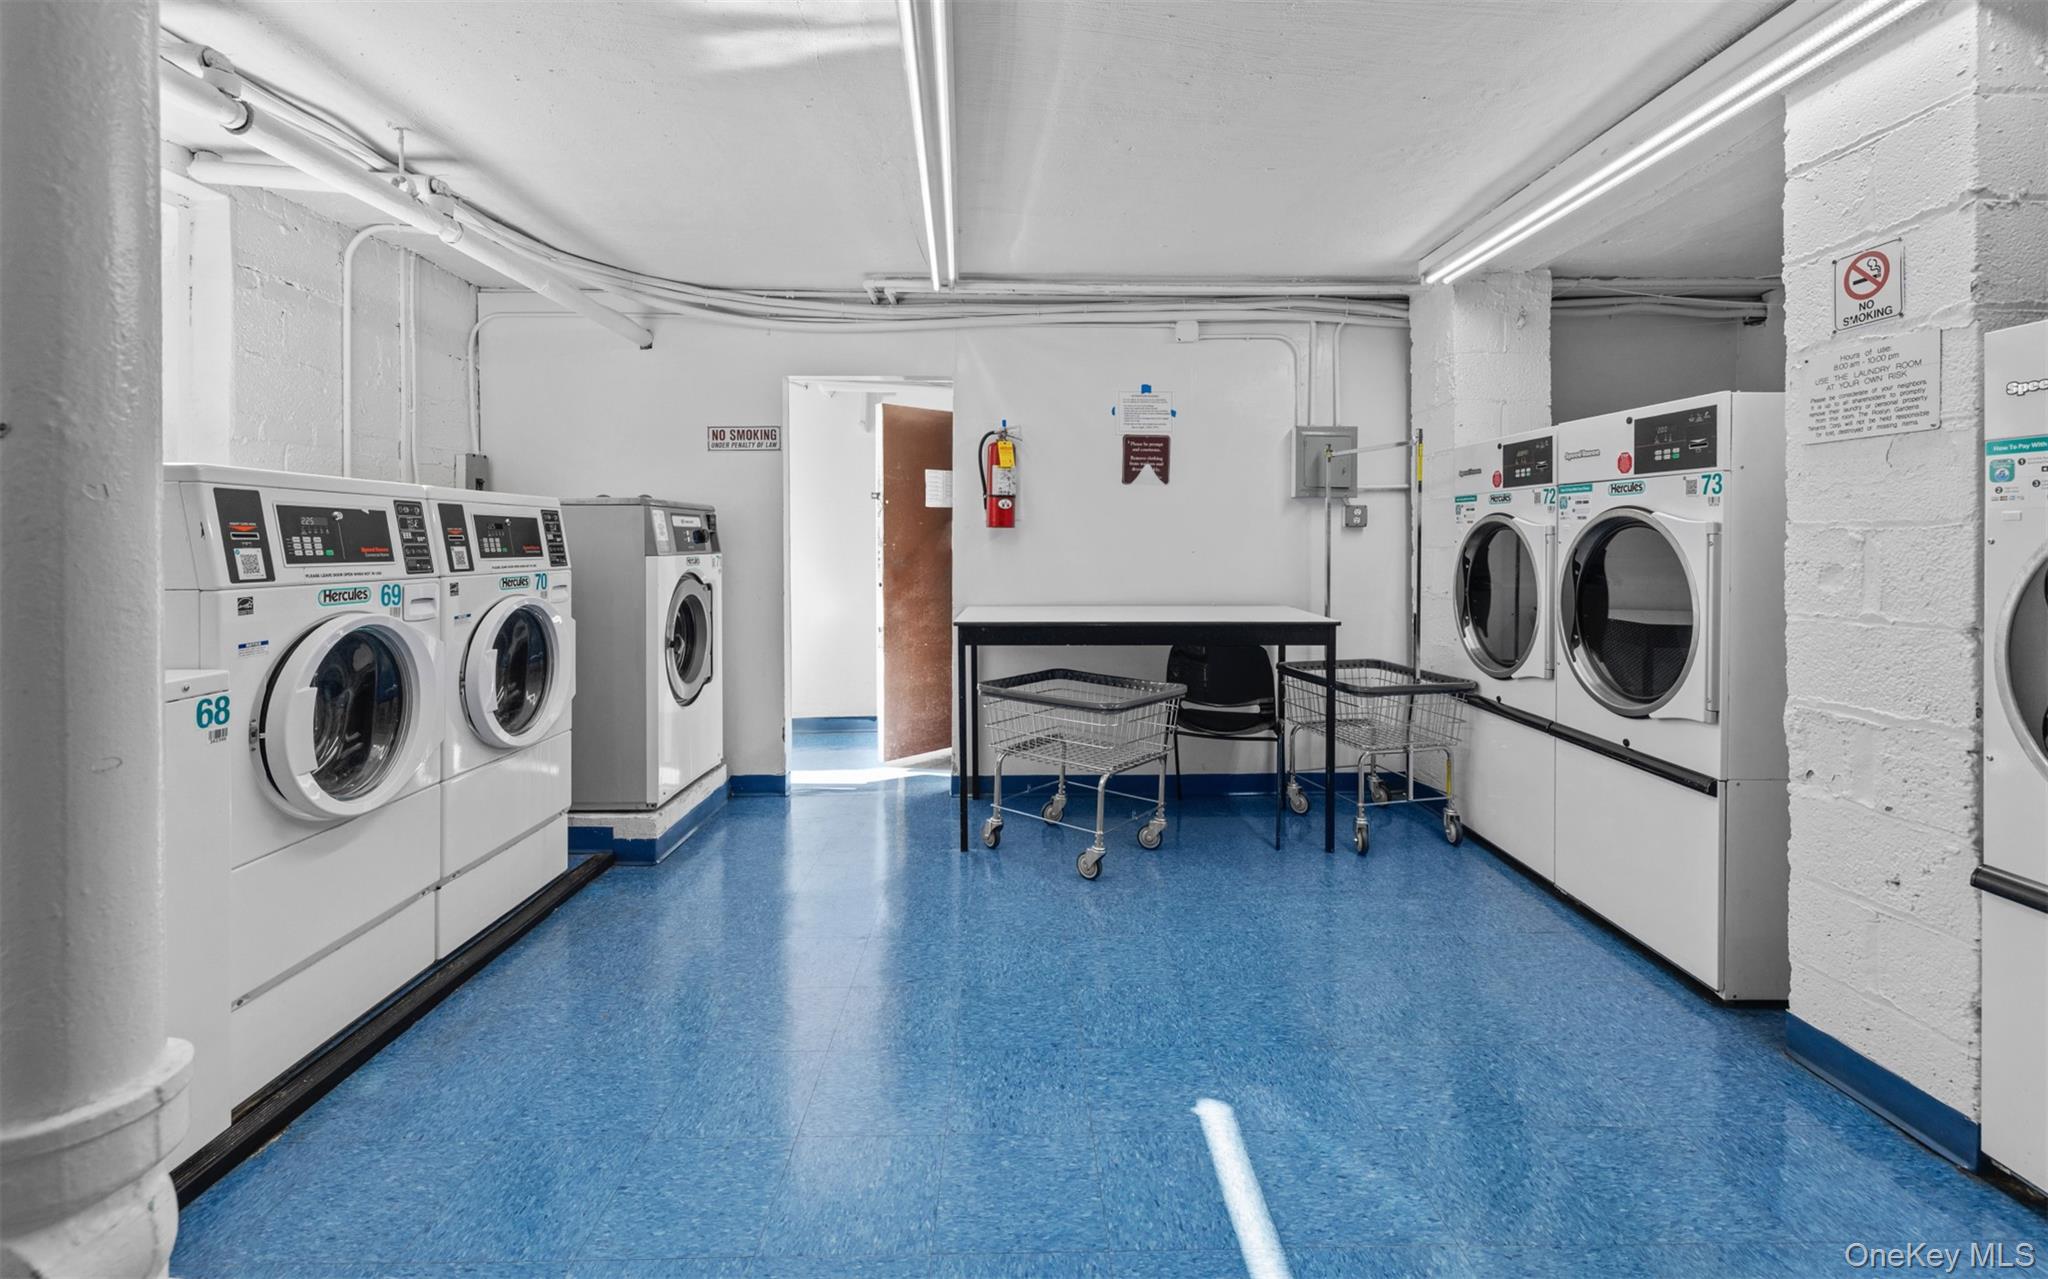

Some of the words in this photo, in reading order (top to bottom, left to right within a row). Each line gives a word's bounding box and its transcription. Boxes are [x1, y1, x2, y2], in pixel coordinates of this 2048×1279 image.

[1859, 300, 1875, 311] NO
[1843, 306, 1893, 327] SMOKING
[1840, 353, 1860, 363] Hours
[1864, 348, 1872, 357] of
[1815, 376, 1829, 386] USE
[1834, 372, 1848, 382] THE
[1853, 365, 1891, 379] LAUNDRY
[1896, 358, 1922, 370] ROOM
[1826, 383, 1835, 391] AT
[1839, 379, 1859, 390] YOUR
[1864, 375, 1882, 385] OWN
[1888, 370, 1907, 380] RISK
[1900, 387, 1926, 397] promptly
[1874, 399, 1898, 409] personal
[1902, 394, 1928, 405] property
[1894, 404, 1920, 413] Gardens
[1896, 410, 1930, 420] responsible
[711, 429, 726, 441] NO
[729, 429, 777, 441] SMOKING
[711, 441, 730, 449] UNDER
[731, 441, 756, 449] PENALTY
[756, 441, 764, 449] OF
[765, 441, 778, 449] LAW
[2018, 443, 2030, 451] Pay
[2031, 440, 2047, 449] With
[1611, 483, 1643, 496] Hercules
[1701, 474, 1722, 498] 73
[1544, 488, 1556, 505] 72
[502, 577, 530, 589] Hercules
[535, 573, 548, 590] 70
[323, 587, 369, 604] Hercules
[381, 584, 402, 607] 69
[196, 695, 230, 729] 68
